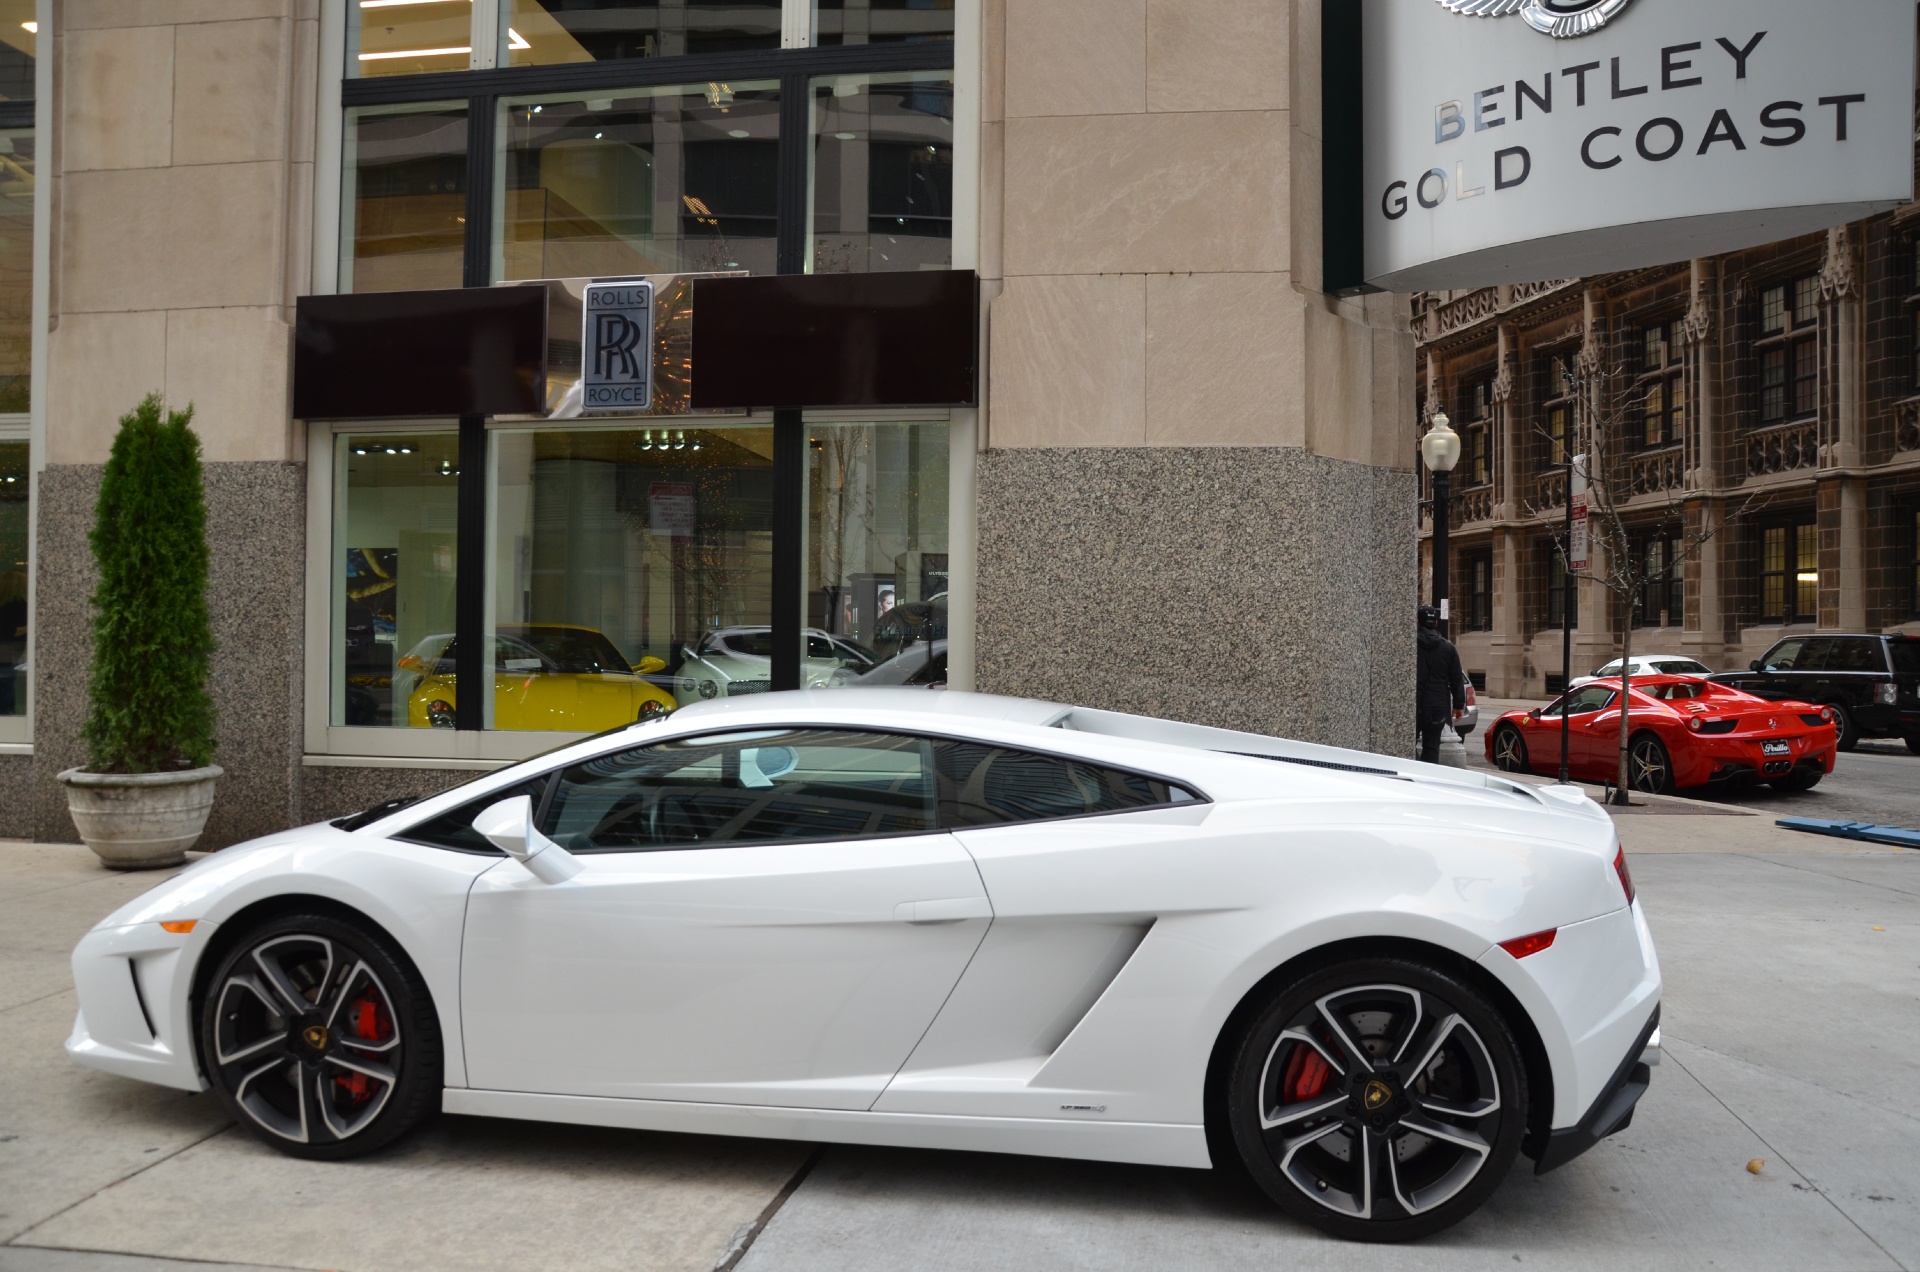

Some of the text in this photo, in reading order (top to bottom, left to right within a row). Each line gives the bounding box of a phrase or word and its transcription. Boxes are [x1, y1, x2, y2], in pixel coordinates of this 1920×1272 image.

[1434, 30, 1768, 144] BENTLEY
[1381, 93, 1865, 221] GOLD COAST
[591, 290, 644, 306] ROLLS
[588, 387, 642, 402] ROYCE
